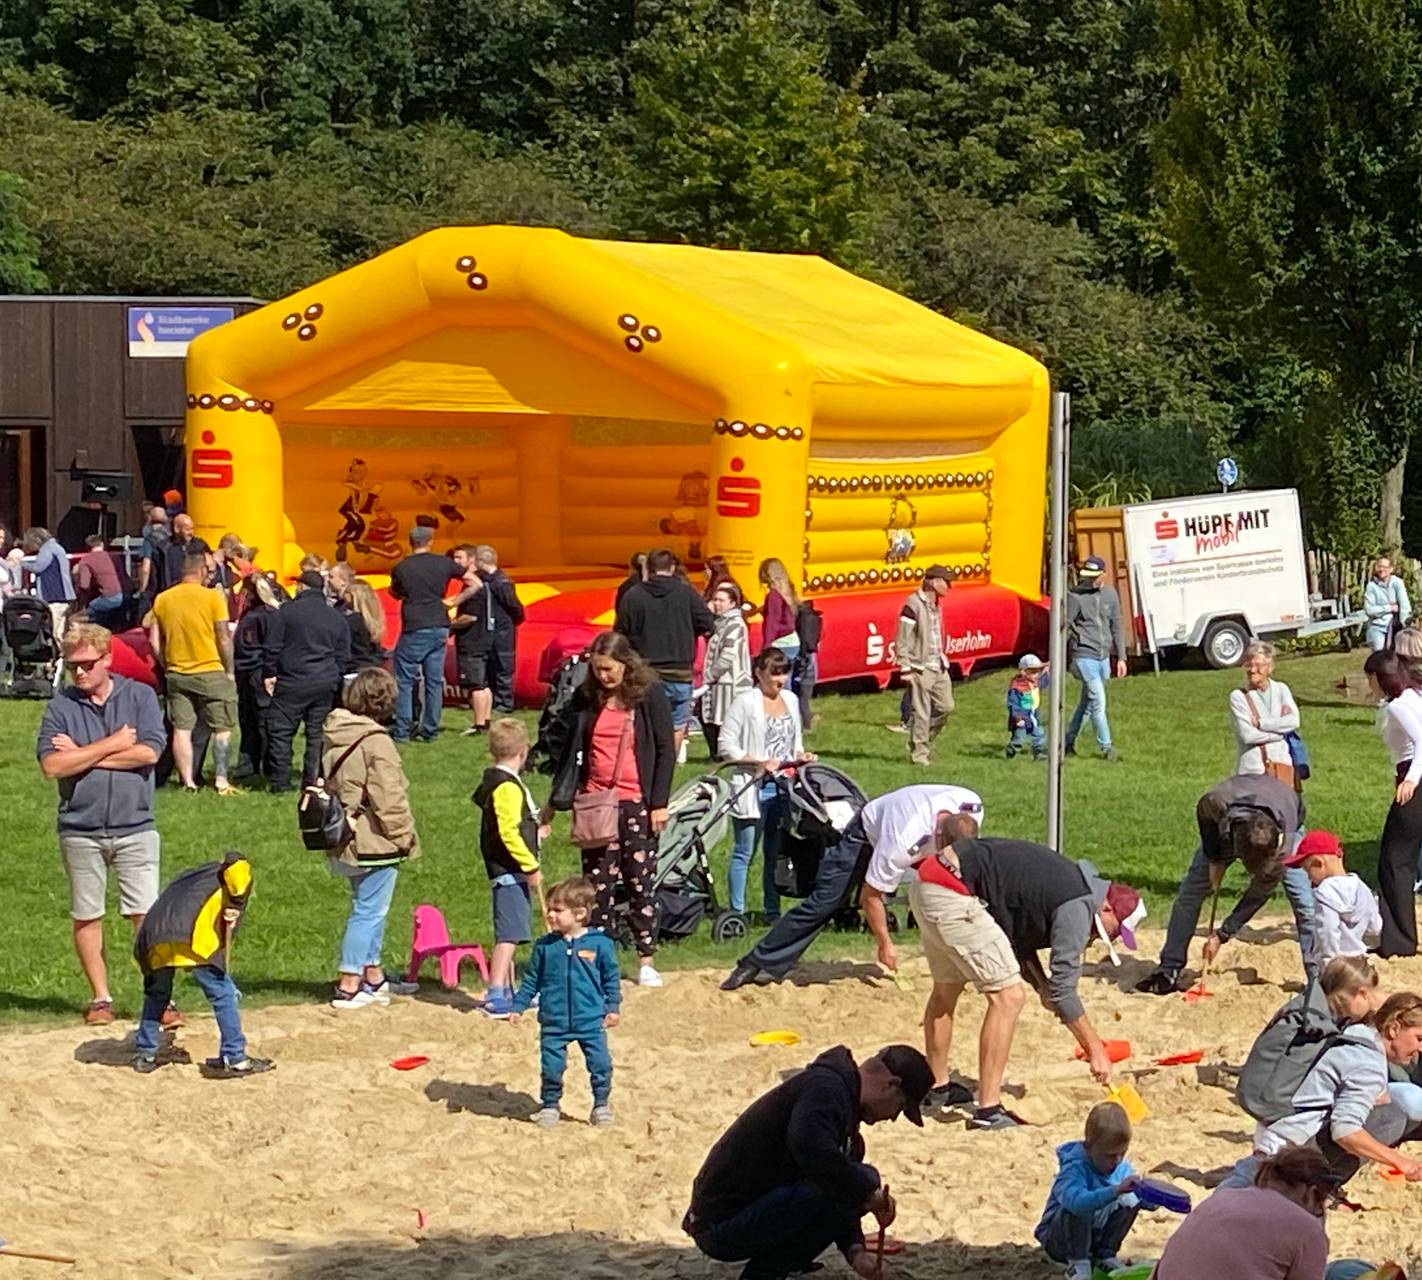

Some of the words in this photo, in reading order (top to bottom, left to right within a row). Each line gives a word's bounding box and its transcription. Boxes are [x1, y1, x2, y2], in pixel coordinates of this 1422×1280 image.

[1184, 513, 1233, 537] HÜPF
[1238, 508, 1270, 531] MIT
[945, 630, 992, 654] Iserlohn
